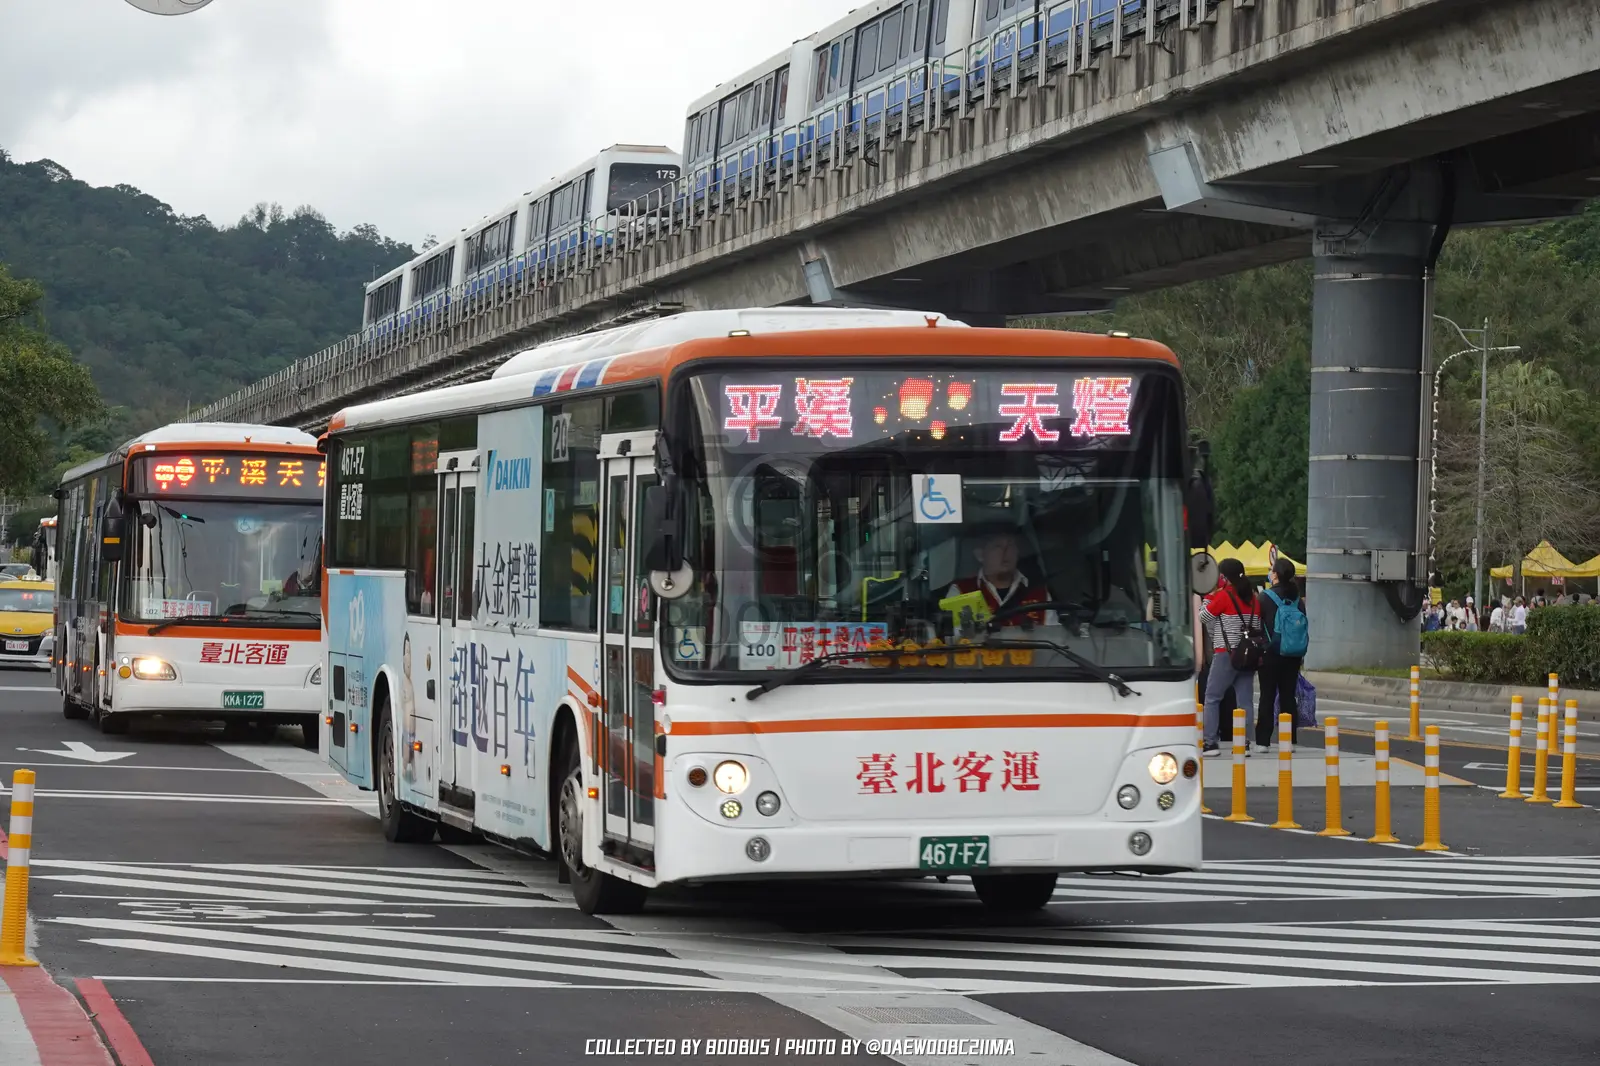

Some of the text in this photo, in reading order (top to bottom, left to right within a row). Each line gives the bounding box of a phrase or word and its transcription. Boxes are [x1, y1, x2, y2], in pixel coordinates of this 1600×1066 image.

[656, 170, 676, 179] 175
[724, 376, 1132, 442] 平溪 天燈
[553, 418, 567, 459] 20
[341, 446, 365, 476] 467-FZ
[495, 457, 531, 490] DAIKIN
[476, 541, 538, 619] 大金標準
[199, 642, 290, 665] 臺北客運
[746, 644, 775, 657] 100
[224, 694, 263, 706] KKA-1272
[449, 641, 535, 766] 超越百年
[856, 751, 1041, 794] 臺北客運
[921, 841, 988, 864] 467-FZ
